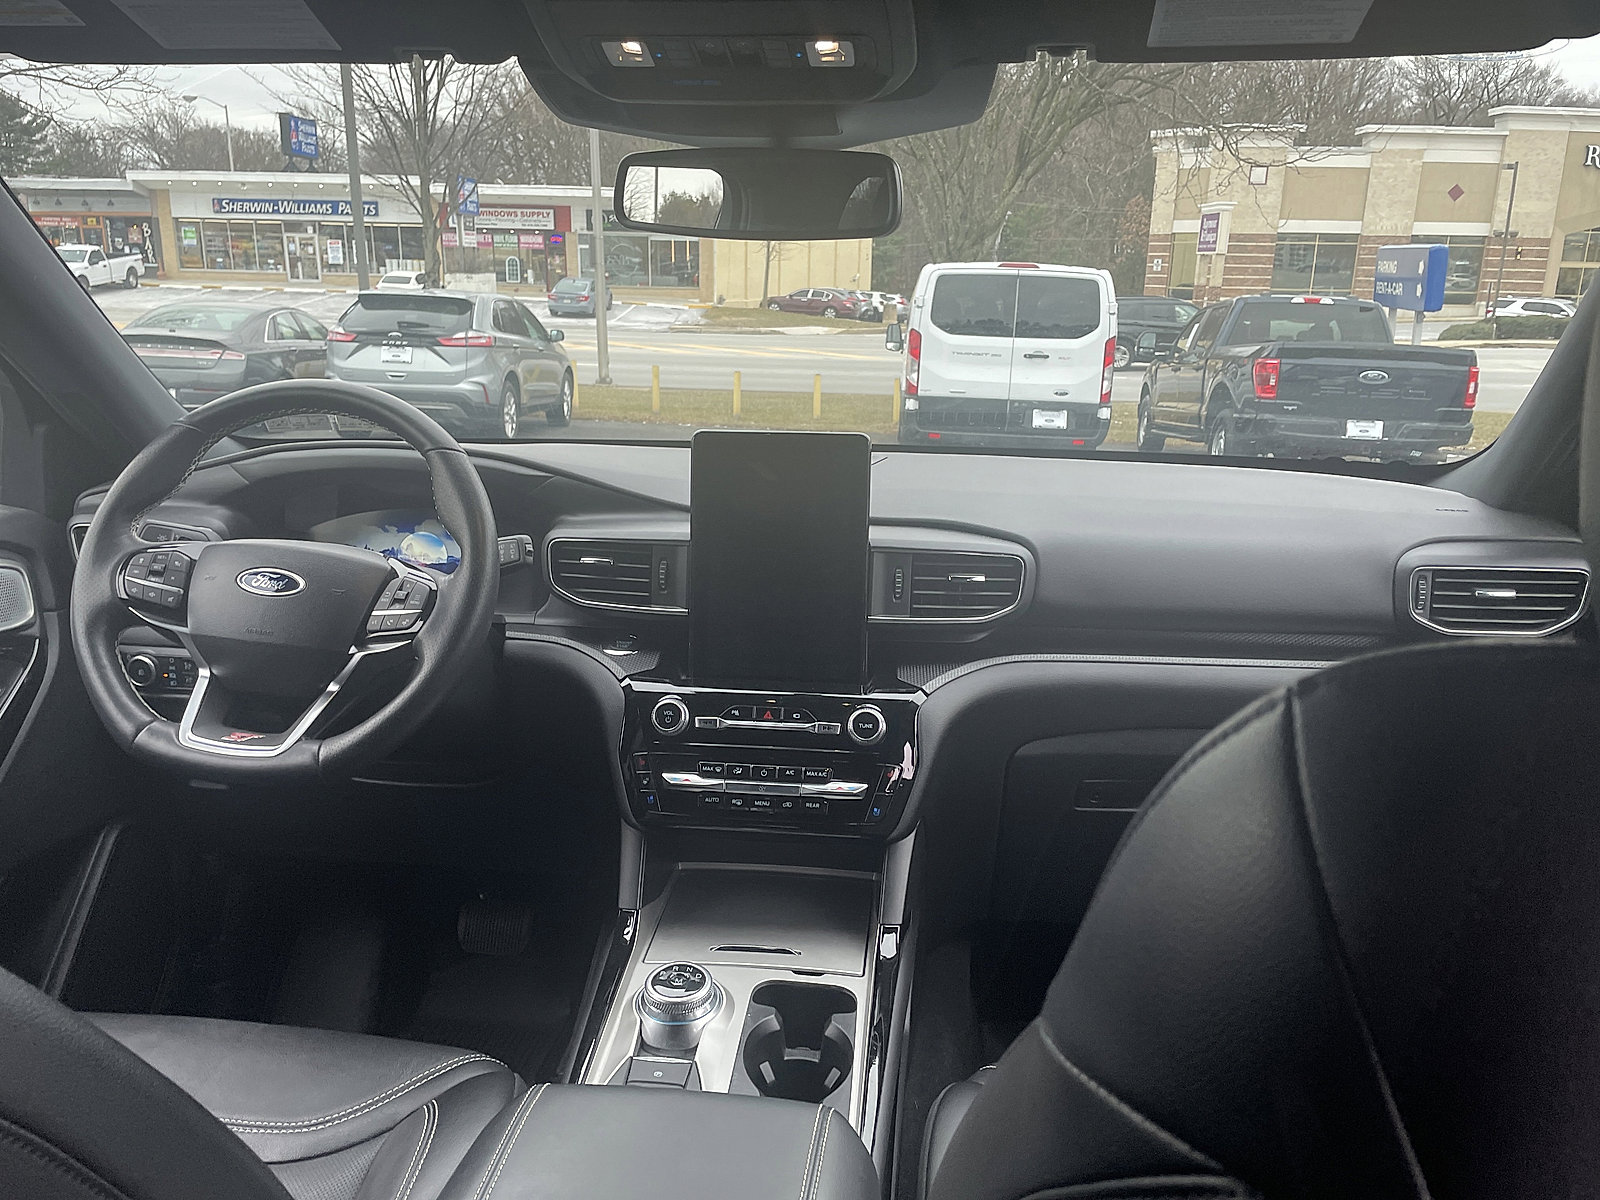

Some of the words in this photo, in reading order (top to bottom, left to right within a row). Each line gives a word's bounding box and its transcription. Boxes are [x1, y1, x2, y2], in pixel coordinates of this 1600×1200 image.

[221, 199, 333, 214] SHERWIN-WILLIAMS
[338, 202, 376, 215] PATS
[478, 210, 518, 218] WINDOWS
[1377, 260, 1398, 273] PARKING
[1375, 281, 1404, 296] RENT-A-CAR
